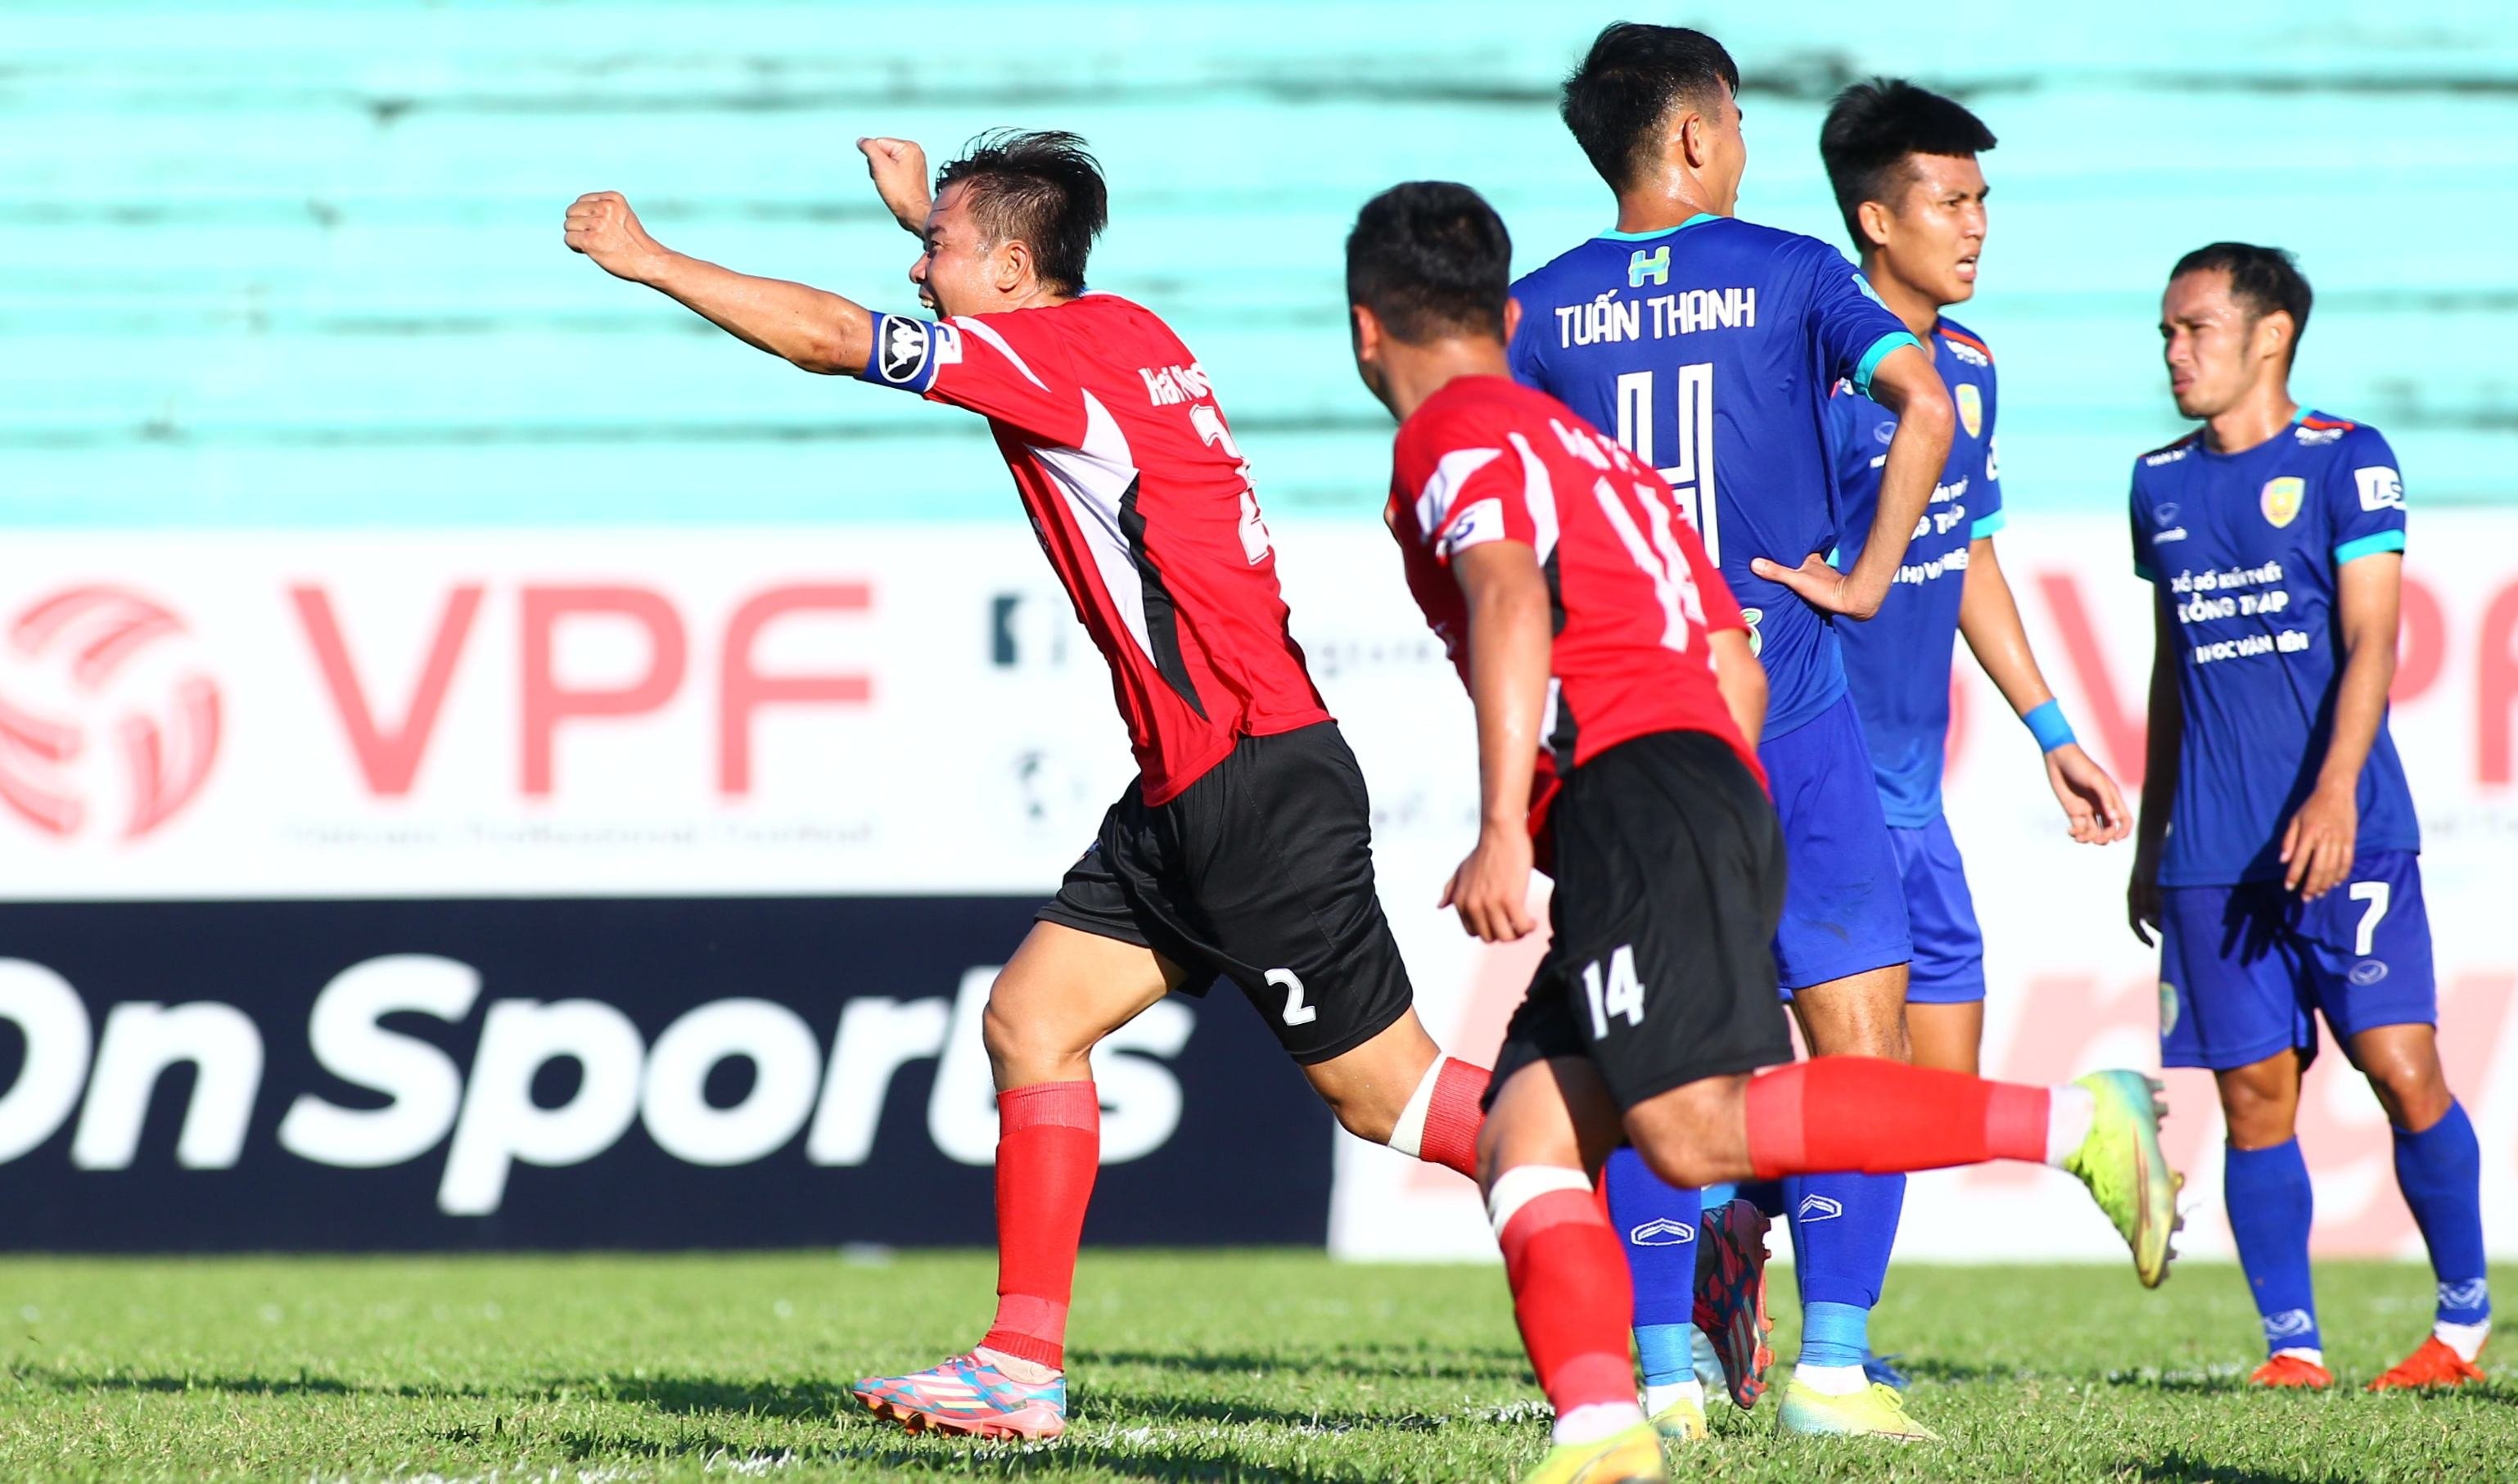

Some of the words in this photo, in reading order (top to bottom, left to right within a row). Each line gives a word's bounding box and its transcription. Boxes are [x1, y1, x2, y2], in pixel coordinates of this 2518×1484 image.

[1555, 289, 1640, 349] TUẤN
[1647, 287, 1756, 339] THANH
[1616, 362, 1721, 569] 4
[289, 582, 873, 796] VPF
[2349, 881, 2390, 956] 7
[1264, 968, 1316, 1026] 2
[1582, 944, 1645, 1040] 14
